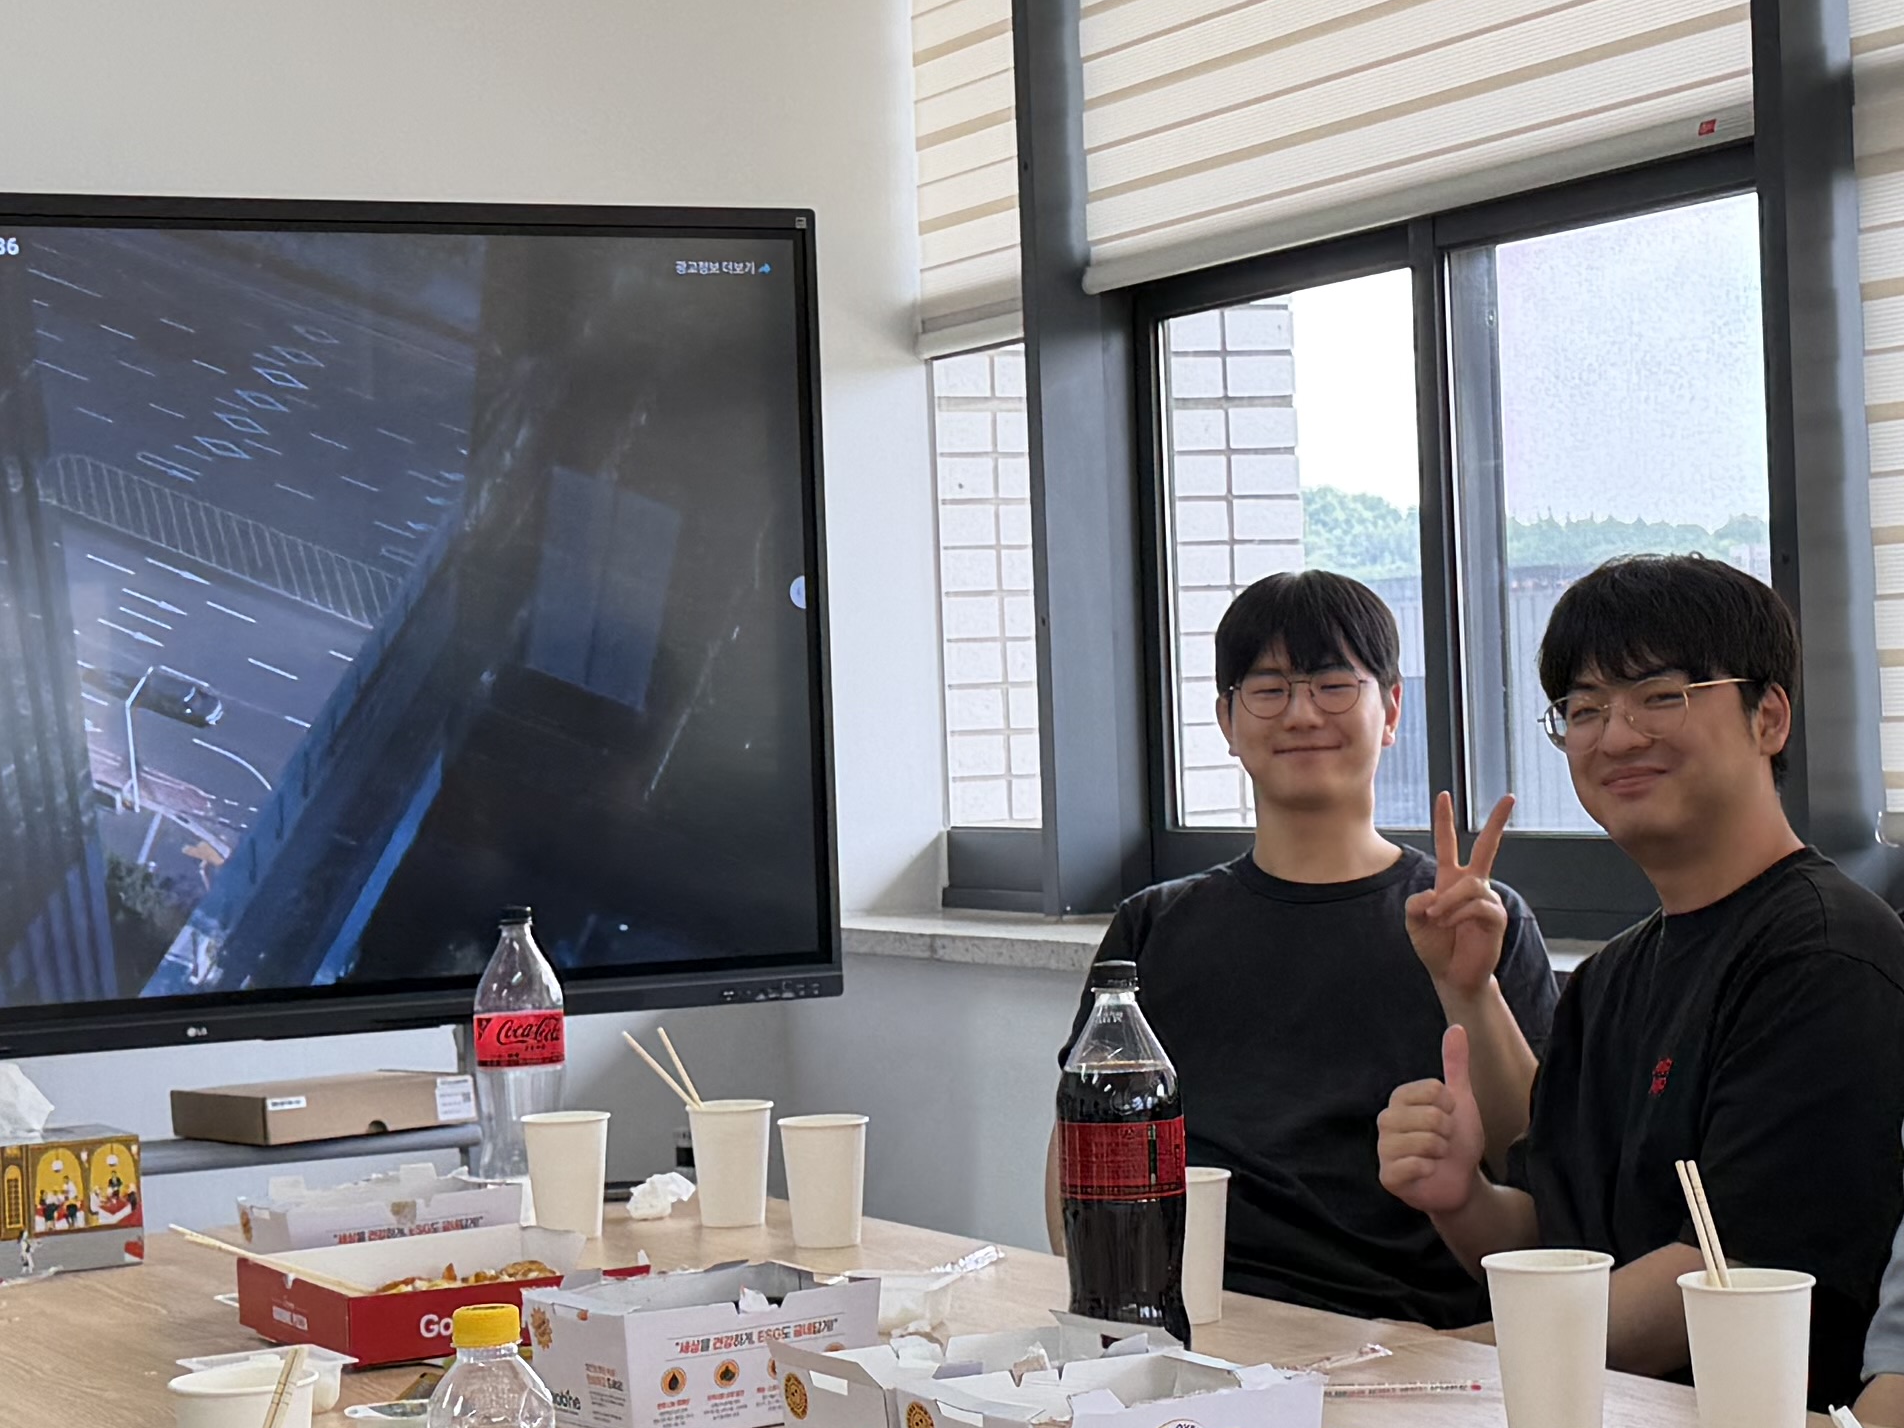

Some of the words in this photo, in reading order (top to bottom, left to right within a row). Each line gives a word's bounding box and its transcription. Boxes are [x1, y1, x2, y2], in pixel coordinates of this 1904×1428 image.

[675, 260, 720, 275] 광고정보
[722, 260, 755, 275] 더보기
[496, 1016, 562, 1046] Coca-Cola
[757, 1325, 793, 1344] ESG도
